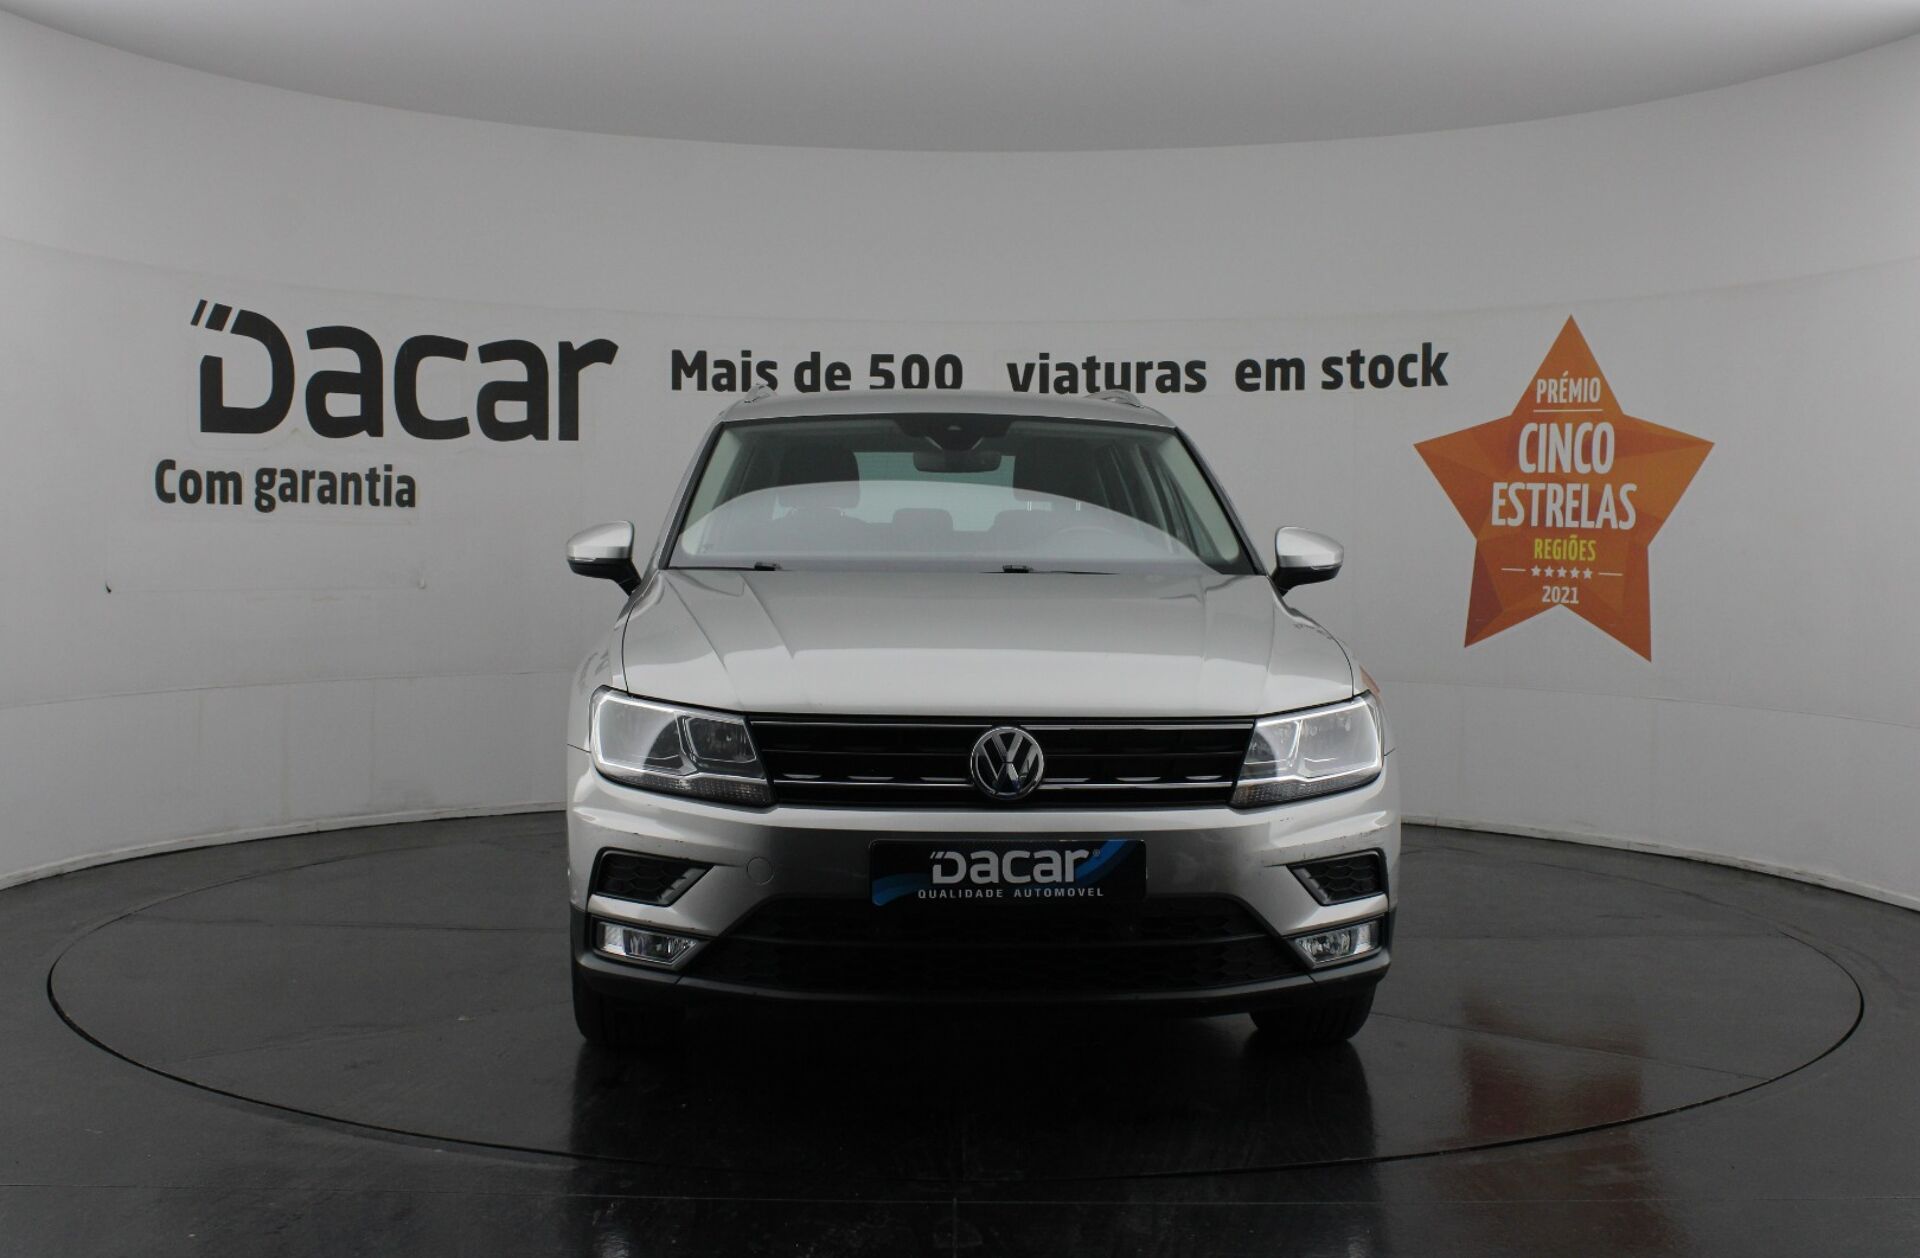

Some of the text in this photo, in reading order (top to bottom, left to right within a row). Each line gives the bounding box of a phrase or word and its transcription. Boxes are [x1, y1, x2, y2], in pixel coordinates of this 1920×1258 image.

[191, 299, 619, 442] Dacar
[671, 342, 1449, 394] Mais de 500 viaturas em stock
[1536, 371, 1601, 404] PRÉMIO
[1518, 422, 1616, 474] CINCO
[154, 459, 417, 513] Com garantia
[1491, 482, 1638, 530] ESTRELAS
[1534, 534, 1597, 562] REGIÕES
[1542, 585, 1580, 605] 2021
[918, 887, 1105, 899] QUALIDADE AUTOMOVEL
